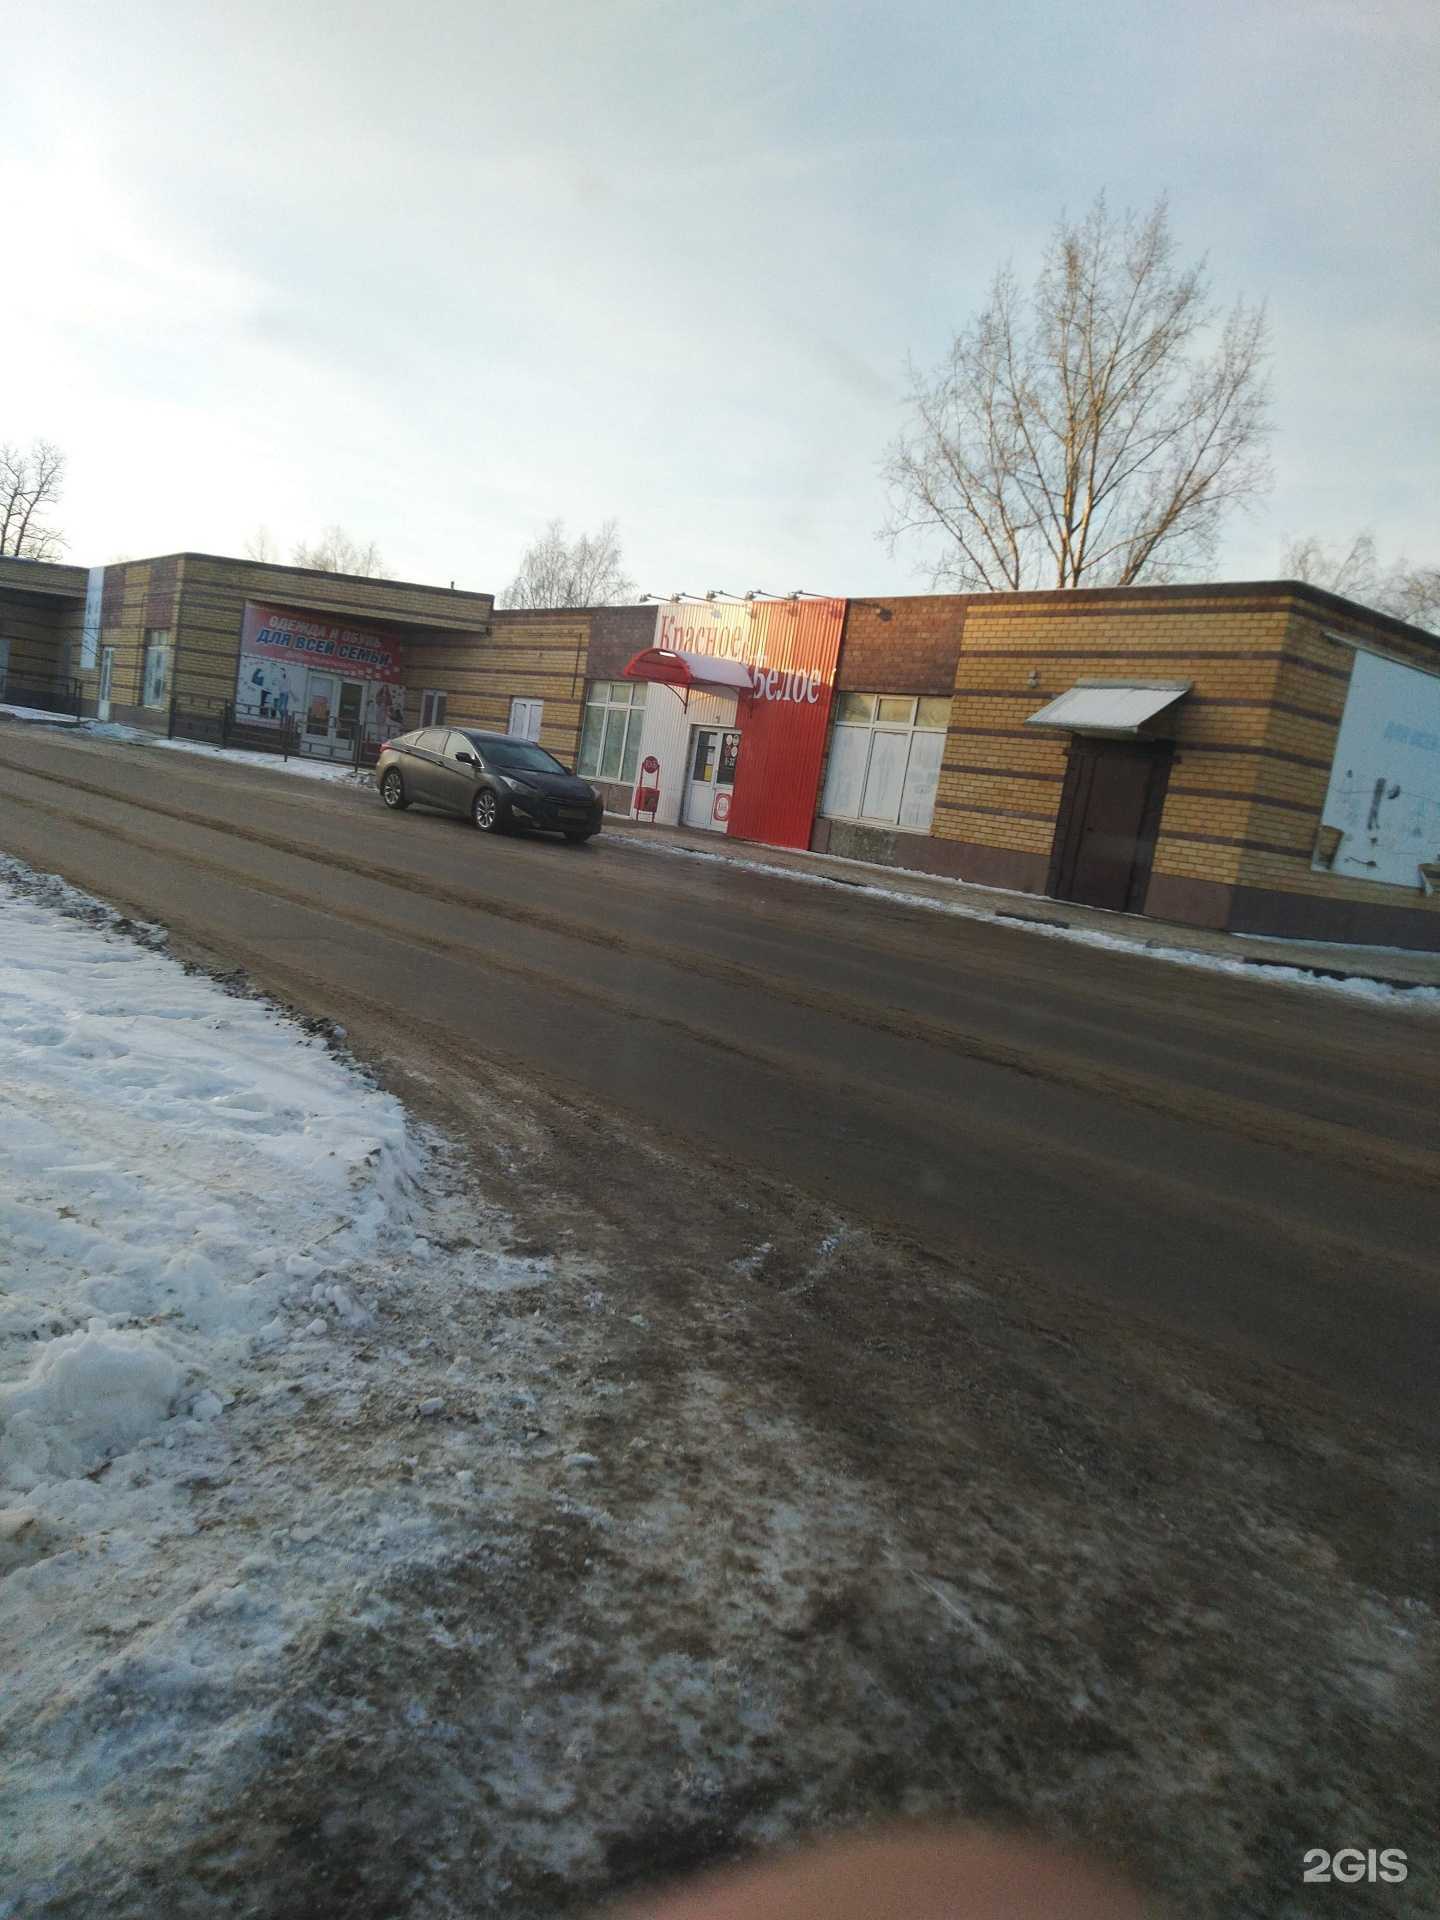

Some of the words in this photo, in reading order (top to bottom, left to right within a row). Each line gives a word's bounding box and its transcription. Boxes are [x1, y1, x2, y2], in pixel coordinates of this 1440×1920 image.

[256, 627, 292, 647] ДЛЯ
[294, 634, 336, 655] ВСЕЙ
[338, 644, 391, 666] СЕМЬИ
[268, 616, 327, 637] ОДЕЖДА
[329, 627, 341, 639] И
[753, 650, 822, 704] Белое
